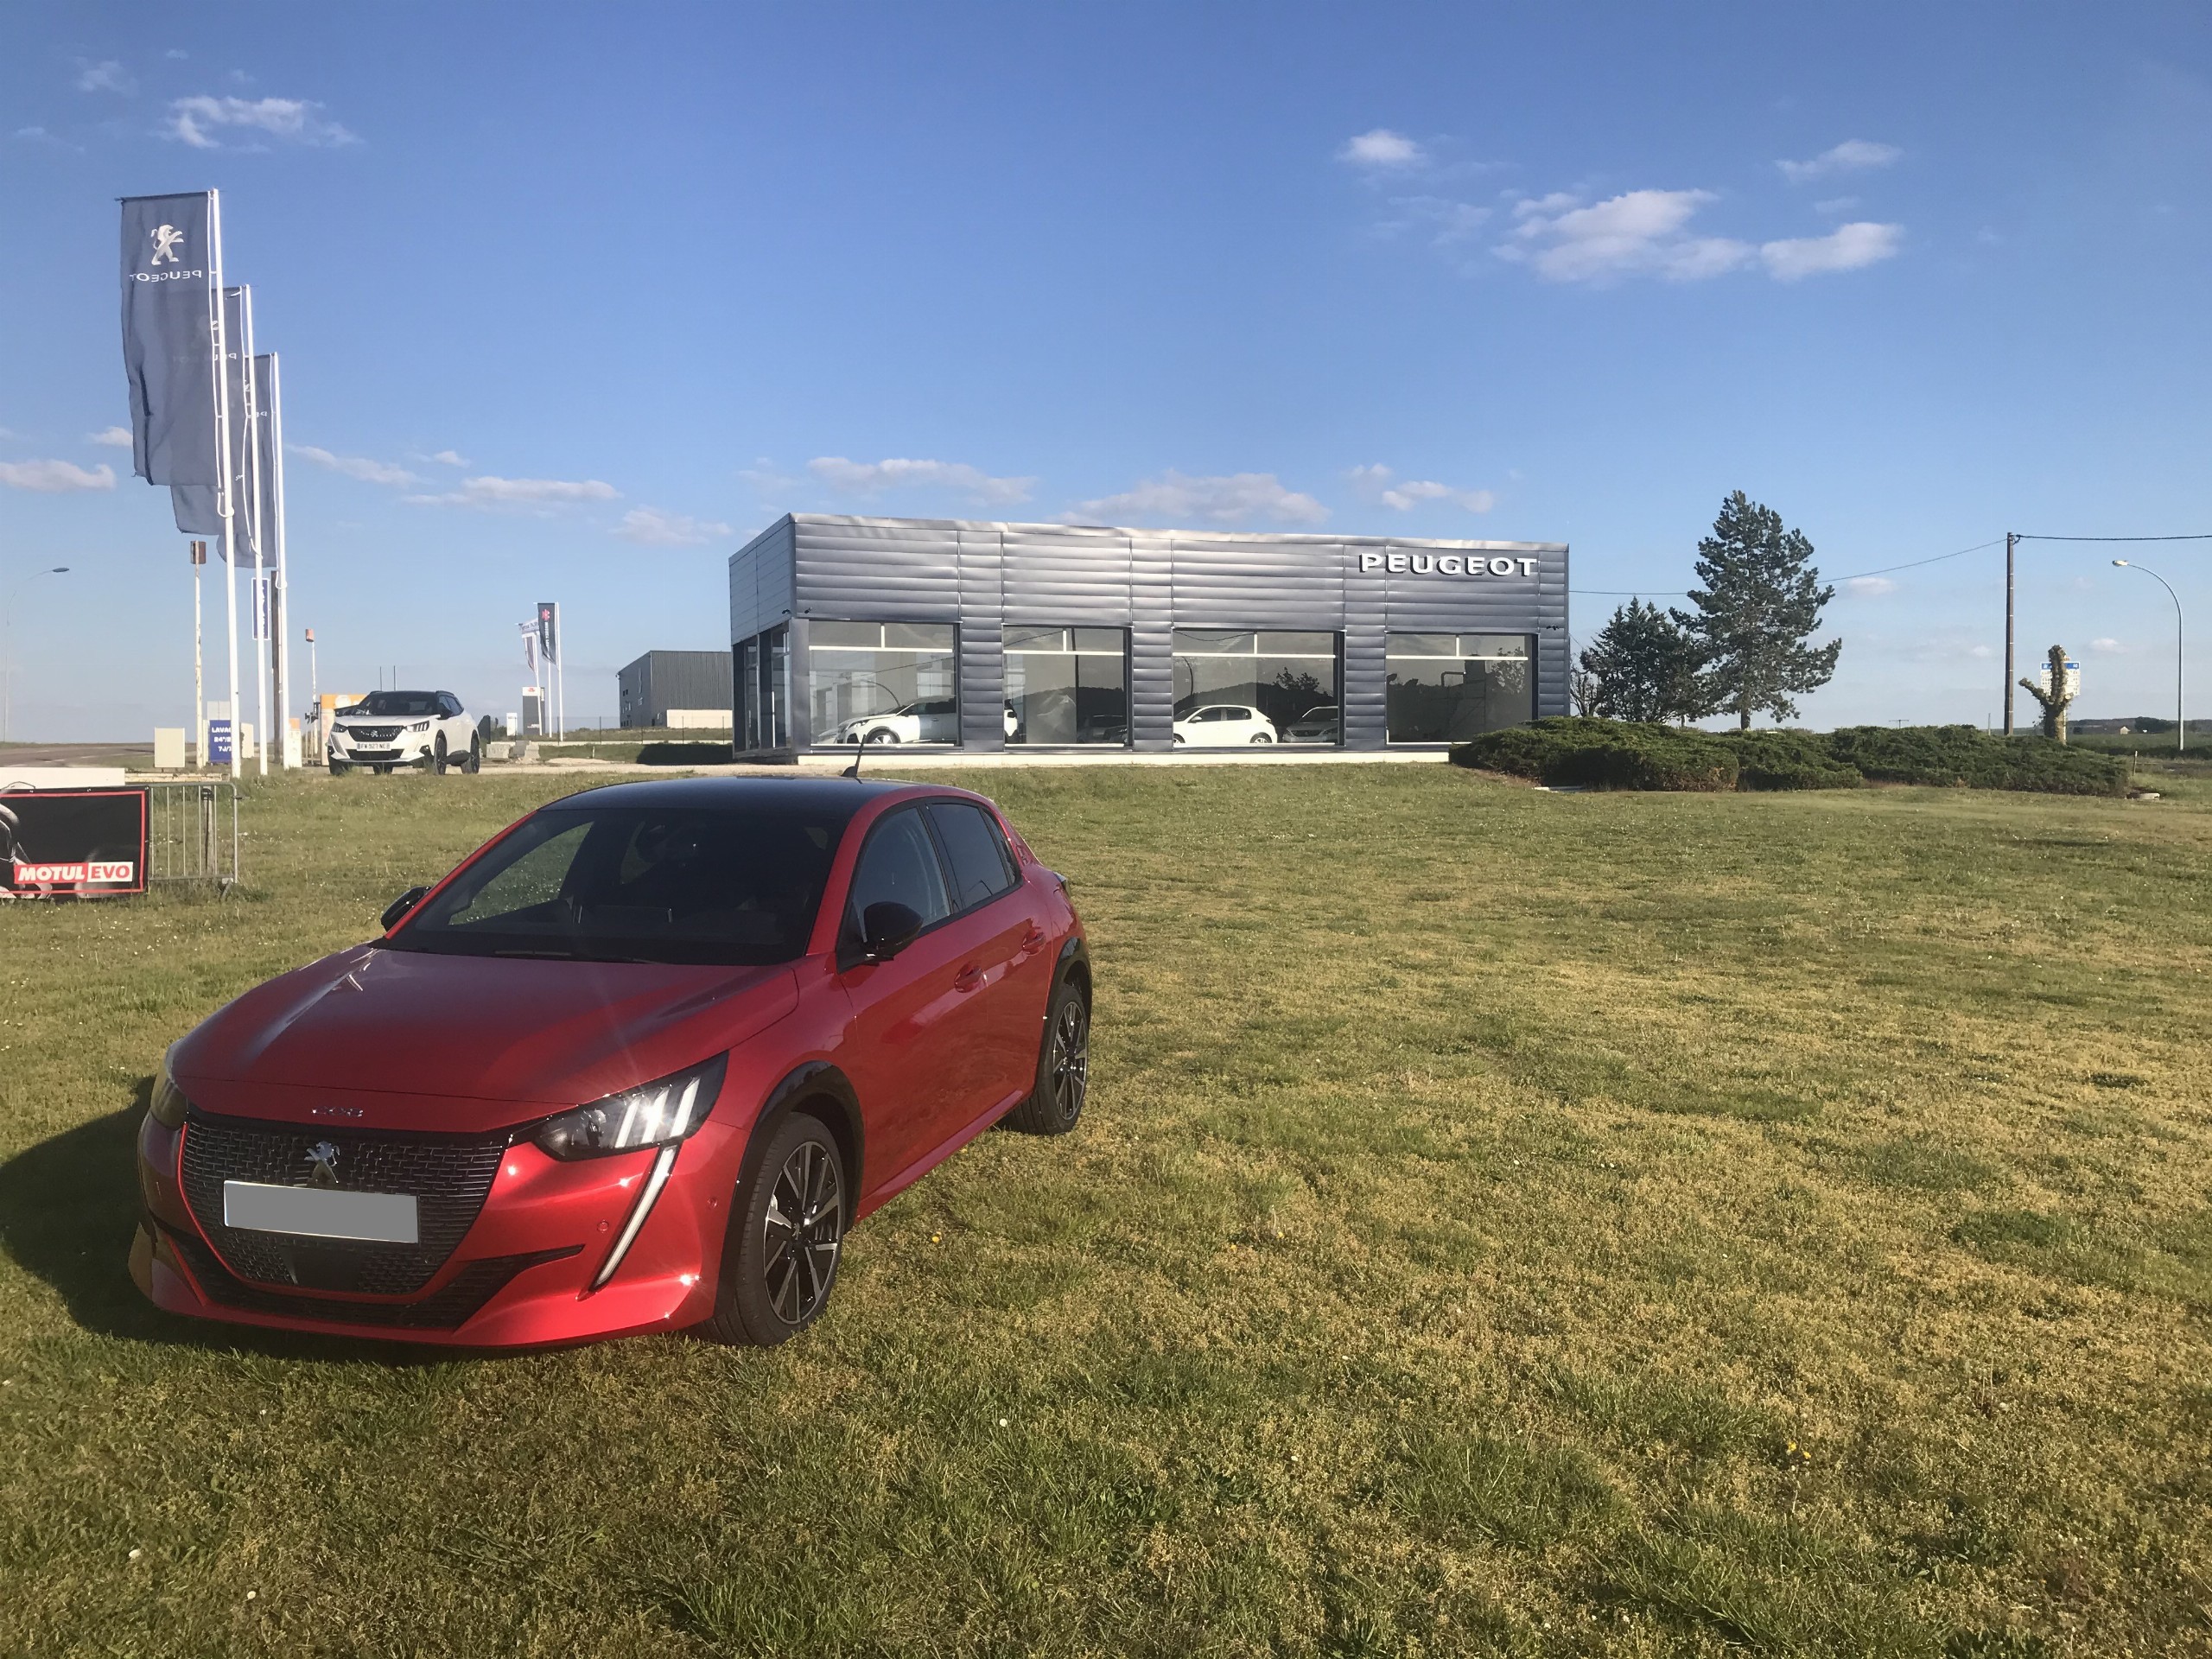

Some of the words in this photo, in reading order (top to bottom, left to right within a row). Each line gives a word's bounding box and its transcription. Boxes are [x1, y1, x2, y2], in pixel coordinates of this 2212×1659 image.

[1360, 552, 1537, 577] PEUGEOT
[18, 865, 86, 881] MOTUL
[91, 865, 130, 880] EVO
